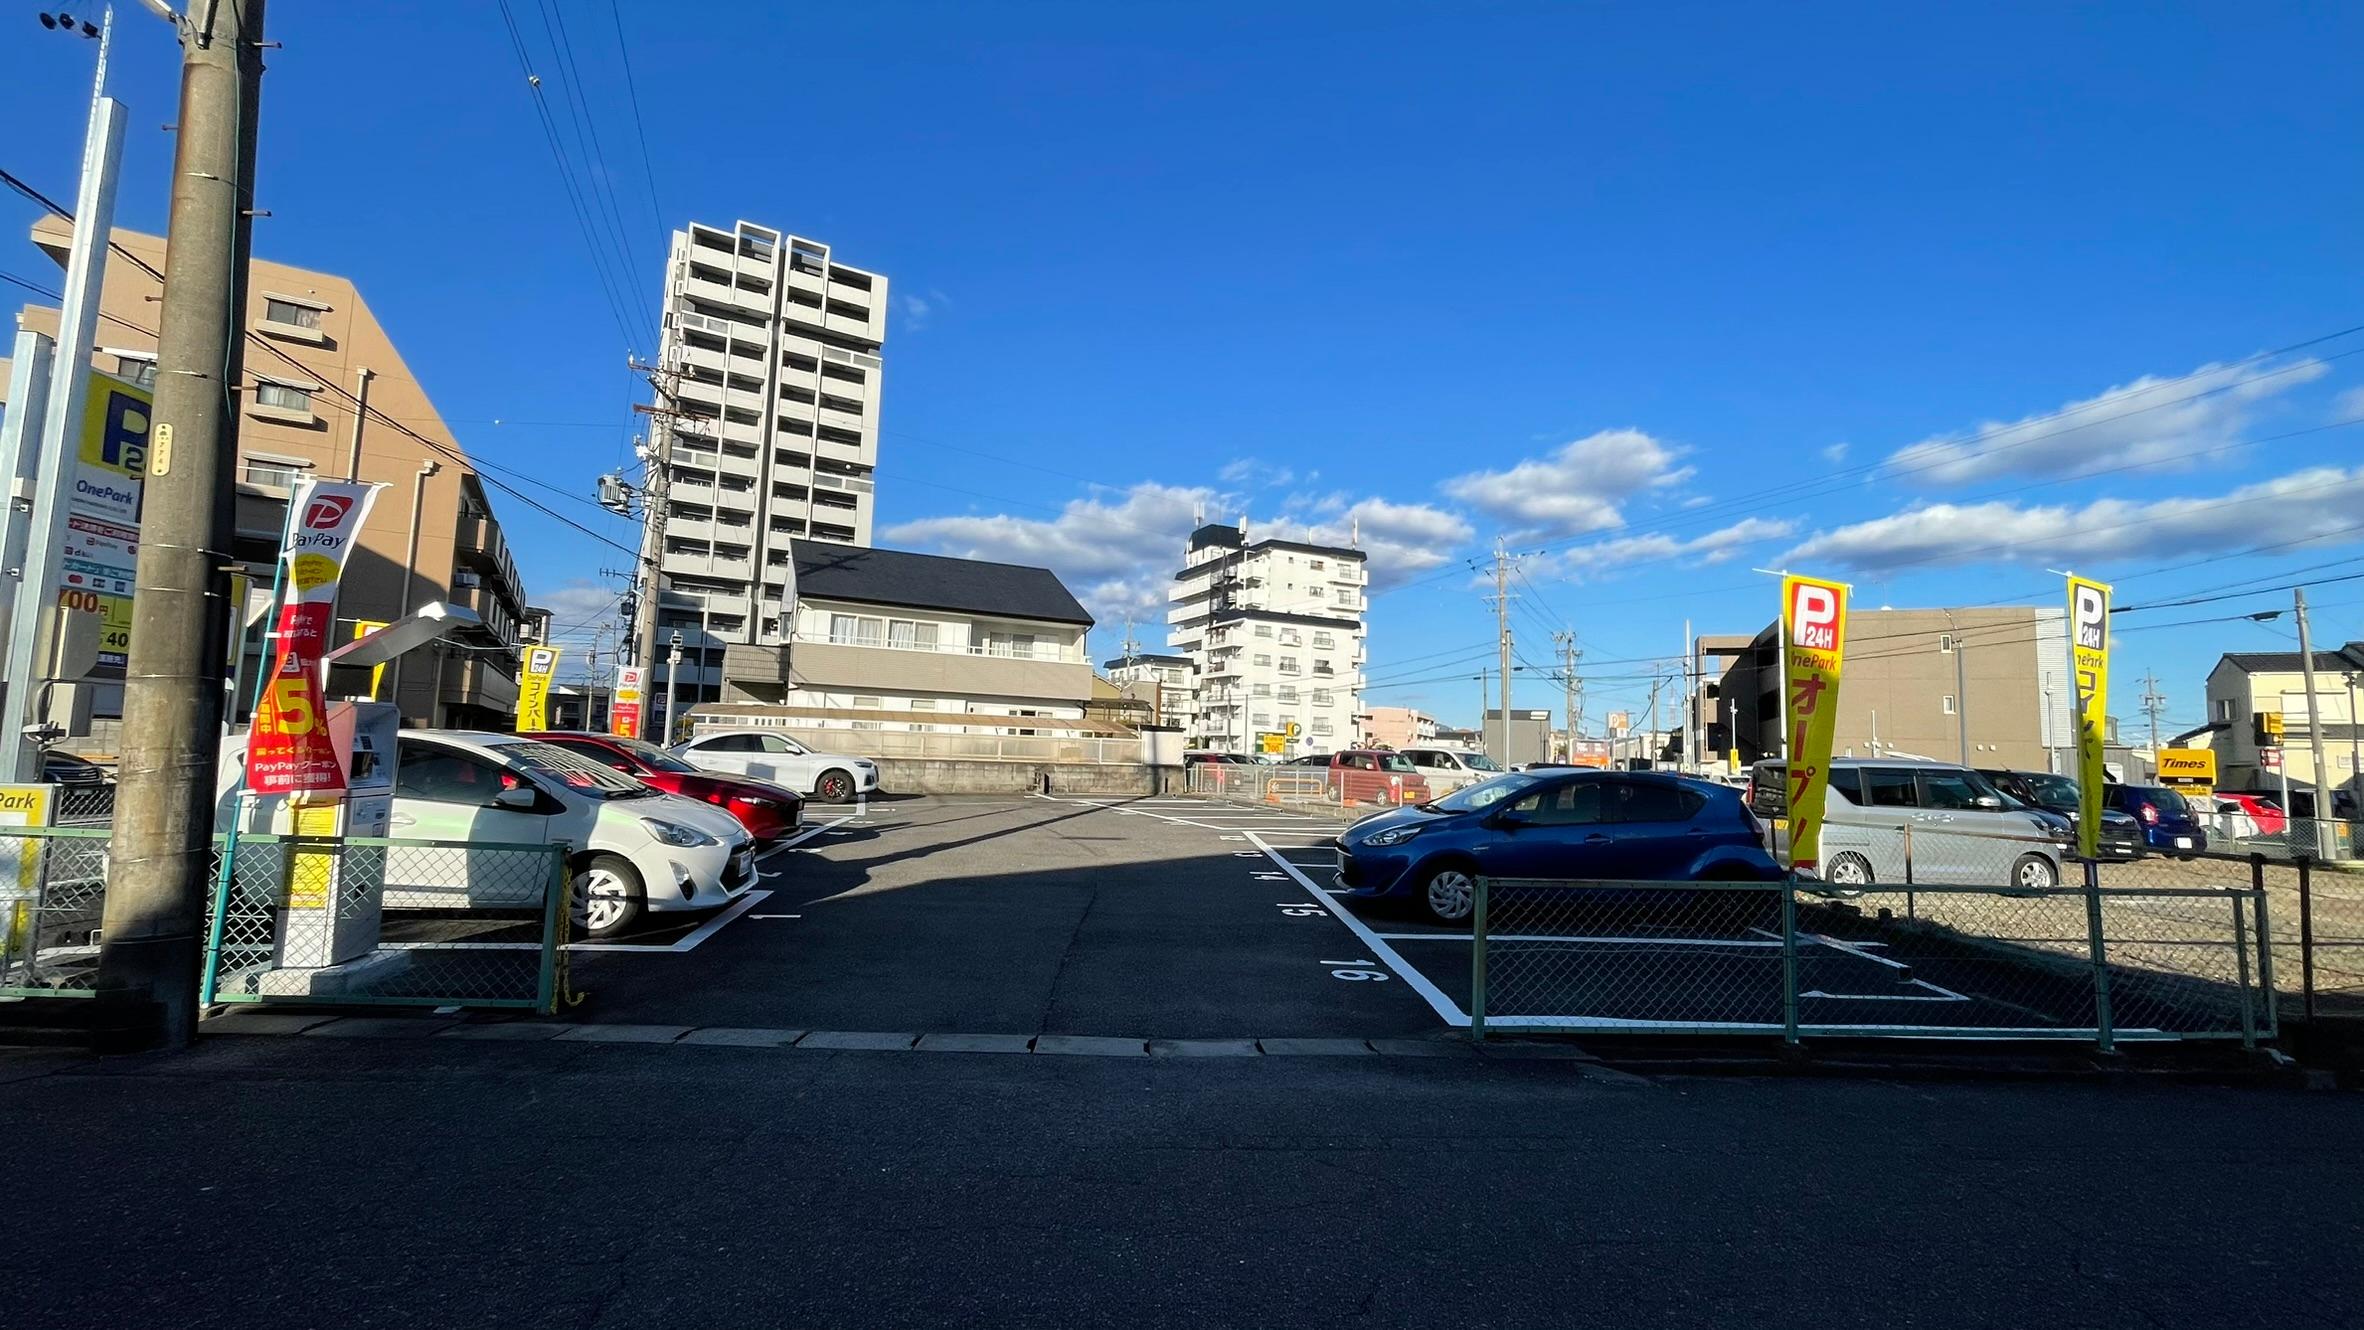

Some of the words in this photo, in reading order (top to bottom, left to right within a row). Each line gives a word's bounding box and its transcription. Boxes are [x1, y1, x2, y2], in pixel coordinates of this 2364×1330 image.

[76, 480, 133, 504] OnePark
[292, 533, 347, 549] PayPay
[1794, 584, 1835, 646] P
[2075, 585, 2103, 645] P
[1806, 626, 1833, 648] 24H
[2082, 626, 2100, 648] 24H
[531, 649, 552, 672] P
[535, 664, 548, 674] 24H
[1791, 653, 1836, 671] nePark
[526, 682, 541, 731] コインパー
[2162, 758, 2207, 768] Times
[1276, 903, 1328, 917] 15
[1320, 959, 1390, 982] 16
